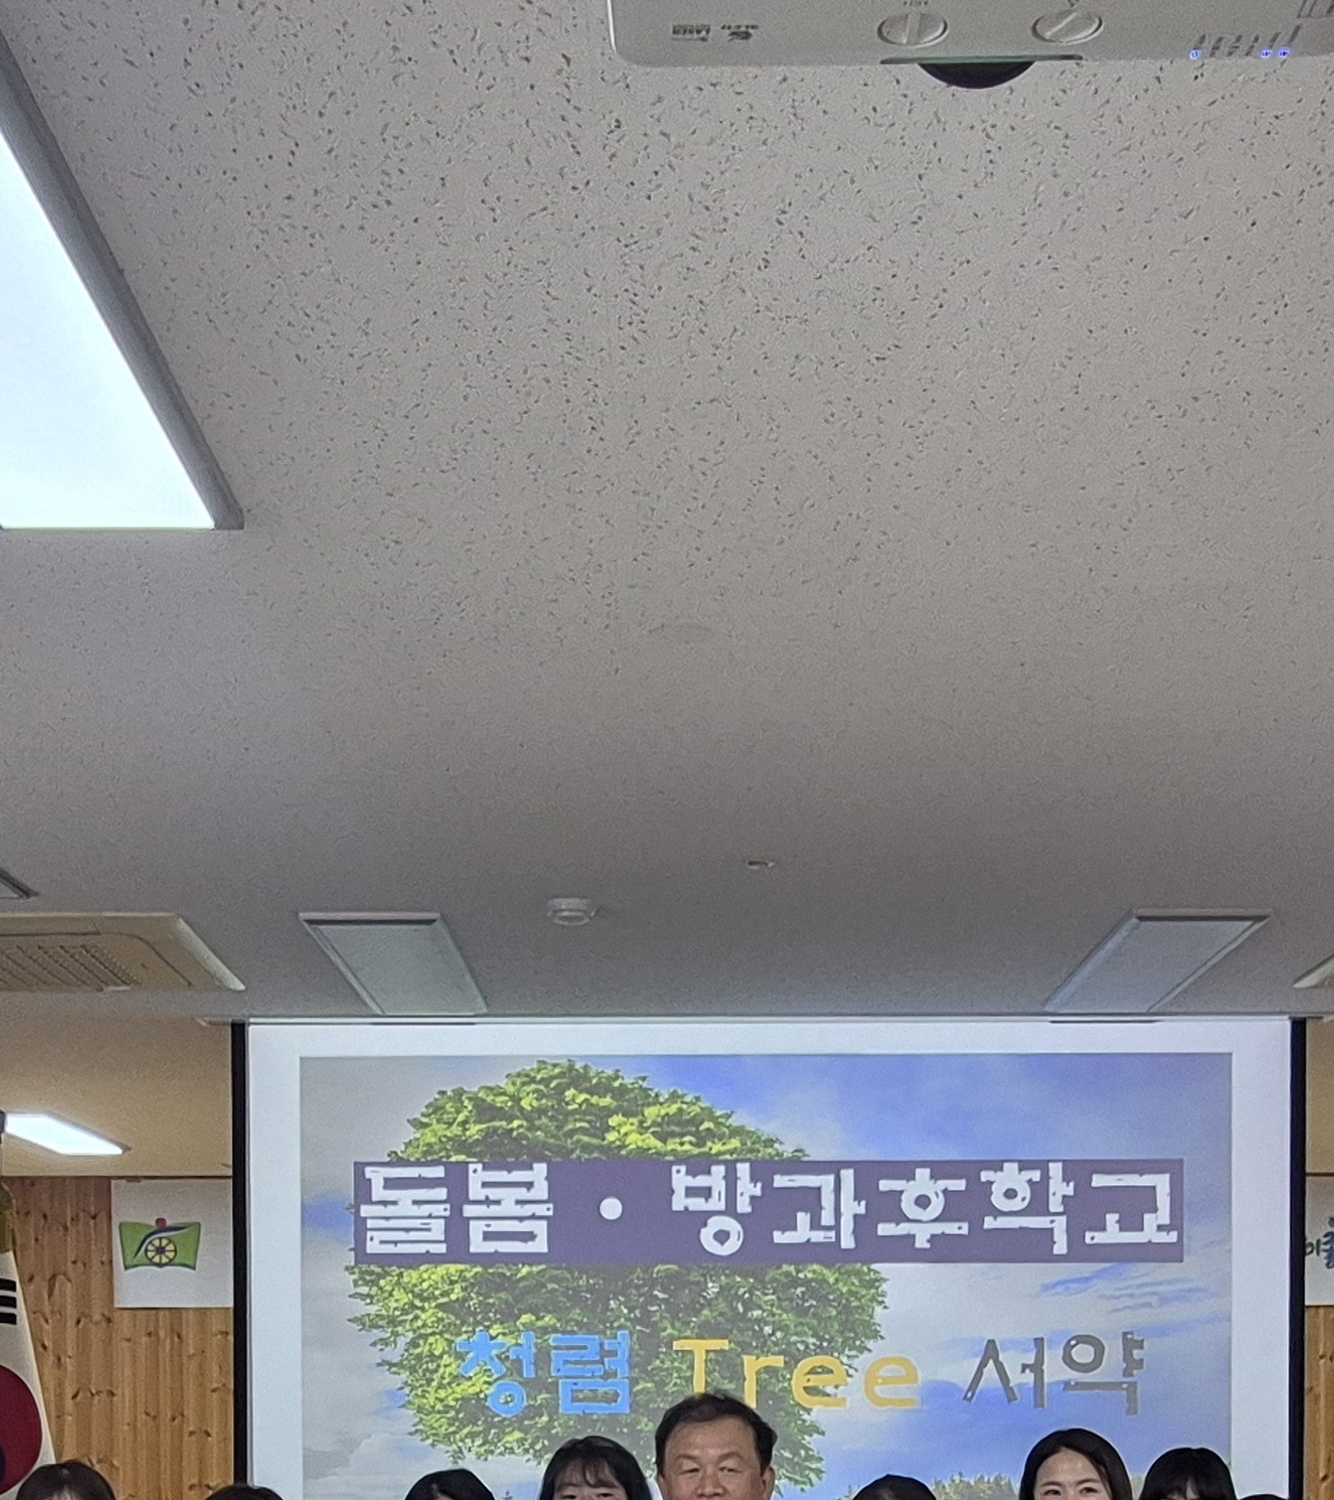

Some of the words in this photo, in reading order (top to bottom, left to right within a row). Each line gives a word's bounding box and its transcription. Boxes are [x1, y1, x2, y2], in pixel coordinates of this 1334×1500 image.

[359, 1162, 554, 1255] 돌봄
[670, 1162, 1181, 1257] 방과후학교
[457, 1330, 632, 1416] 청렴
[671, 1337, 920, 1409] Tree
[963, 1332, 1147, 1416] 서약
